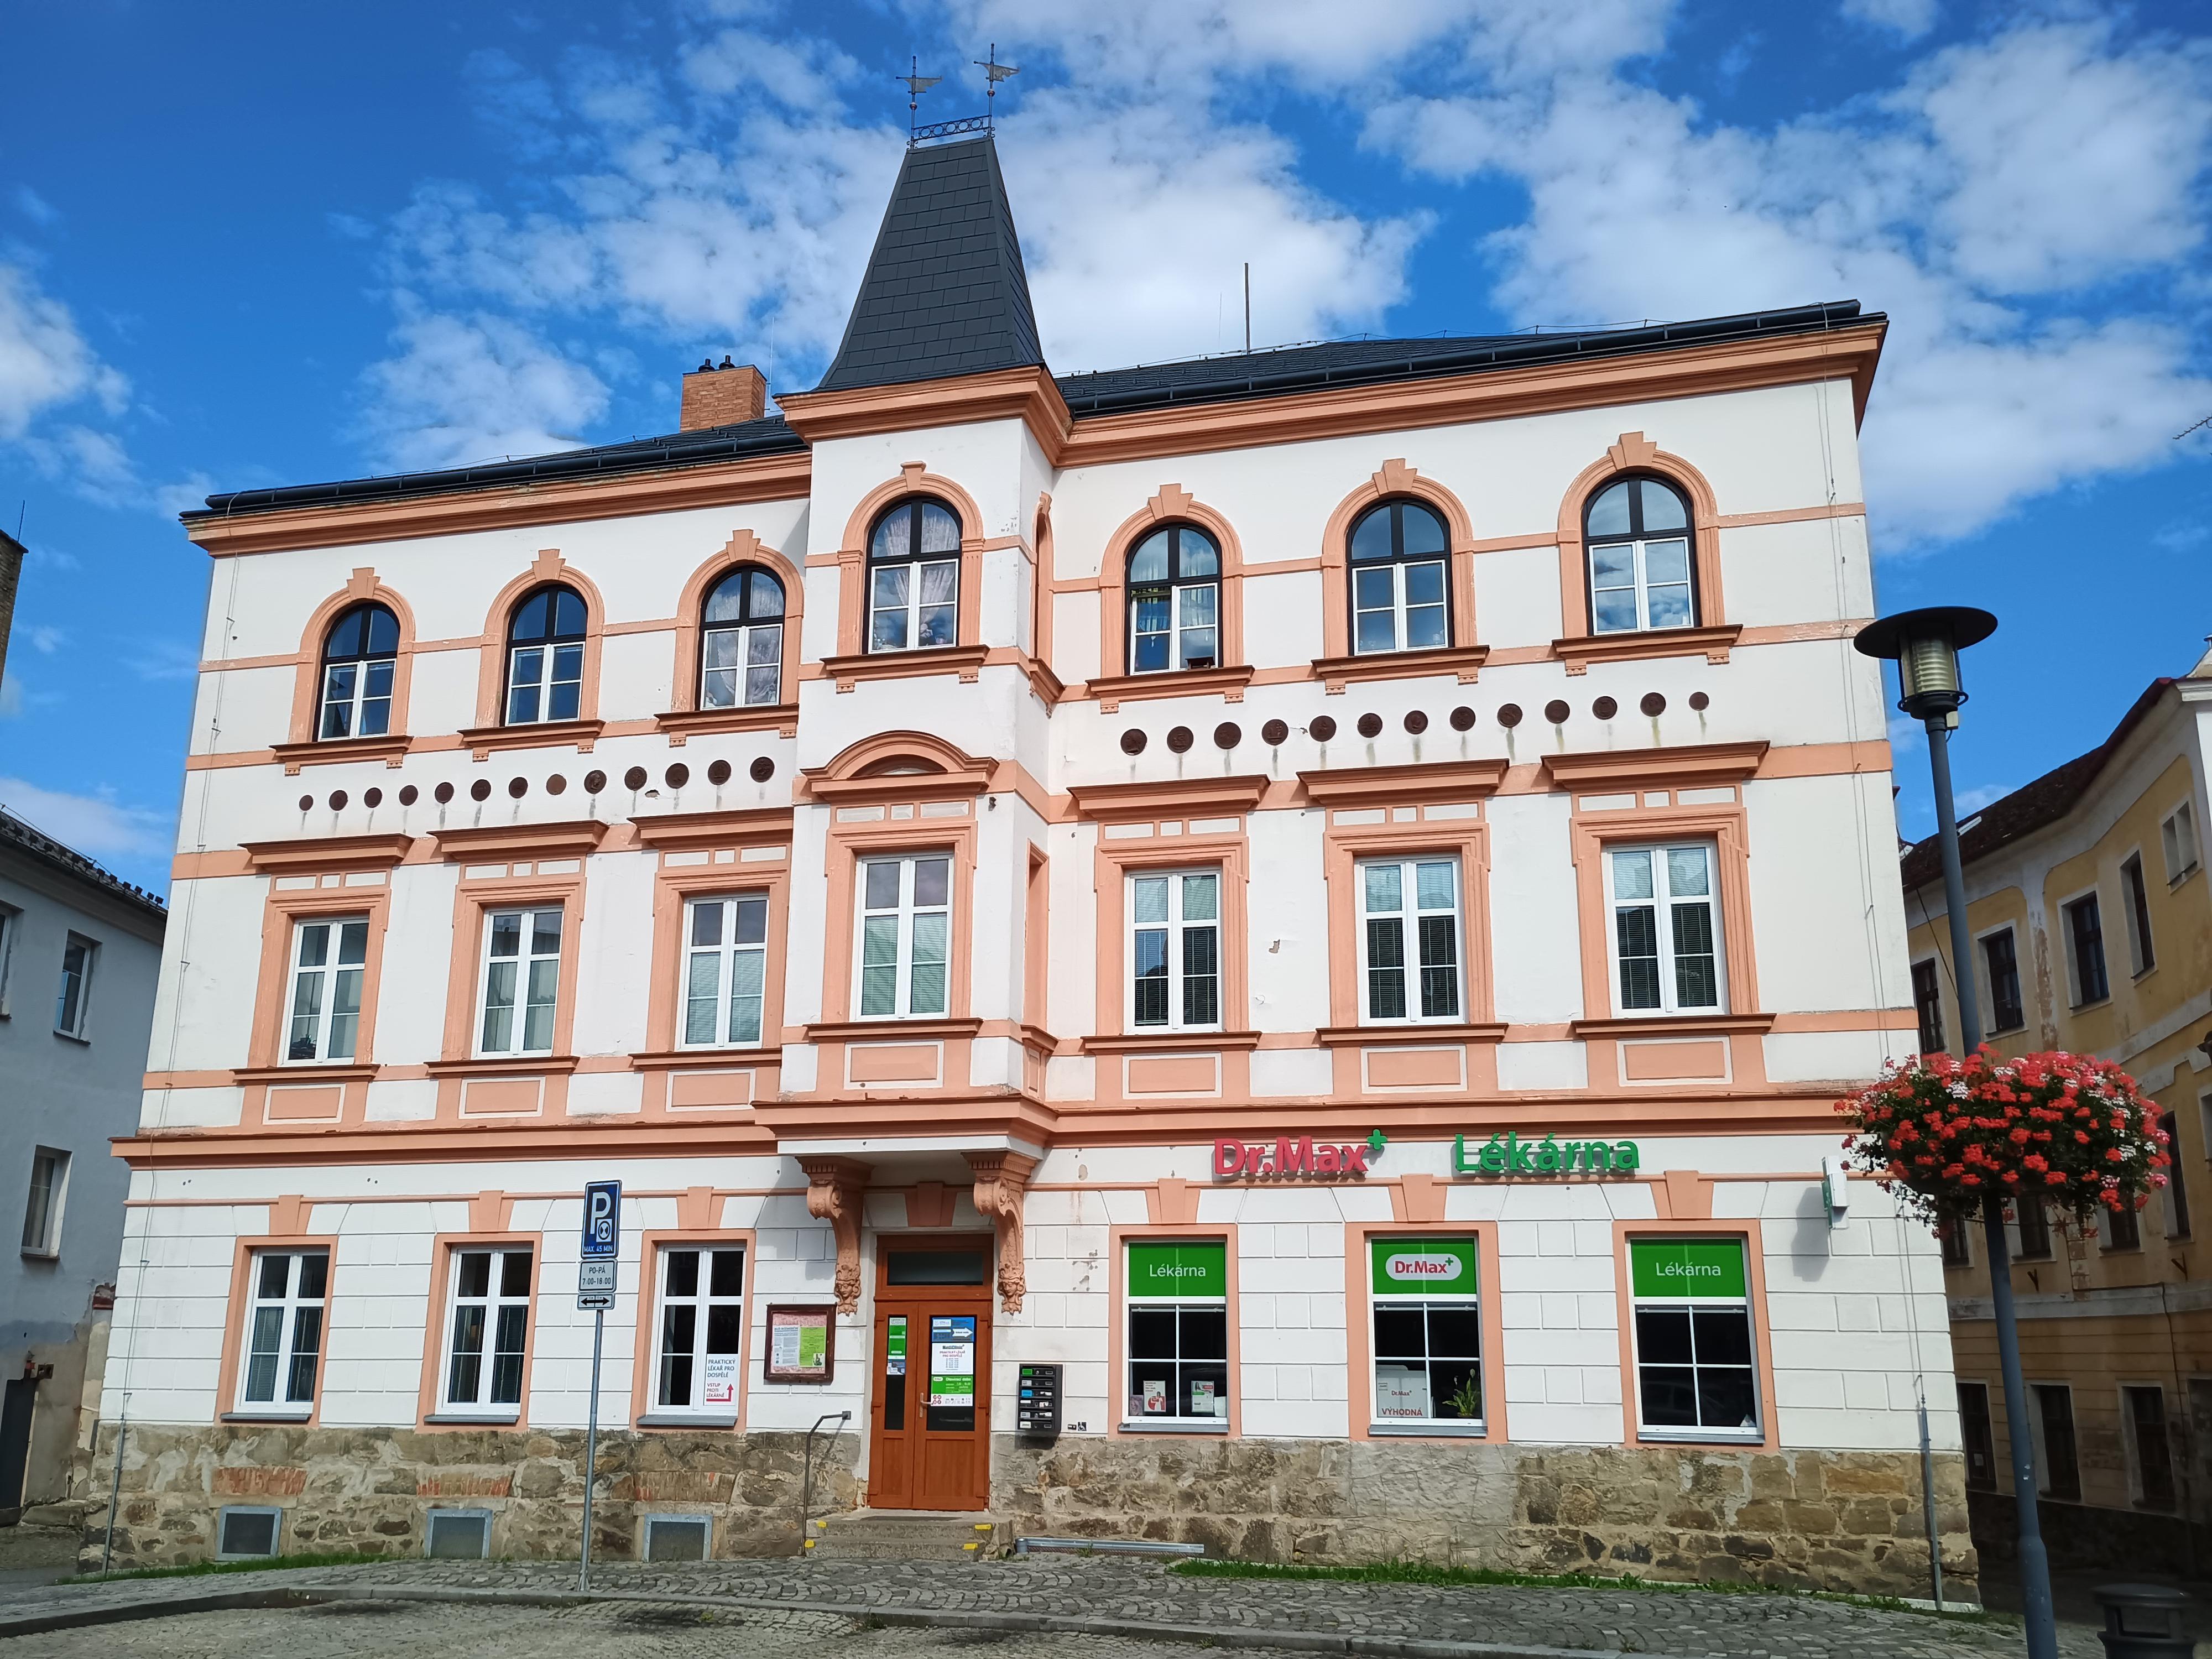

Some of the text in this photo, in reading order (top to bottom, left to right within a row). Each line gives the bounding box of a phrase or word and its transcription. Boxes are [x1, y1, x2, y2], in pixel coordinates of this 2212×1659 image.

[1455, 1131, 1640, 1171] Lékárna
[590, 1192, 611, 1234] P
[589, 1265, 606, 1274] PO-PÁ
[1150, 1263, 1206, 1277] Lékárna
[1656, 1261, 1721, 1276] Lékárna
[1381, 1407, 1423, 1416] VÝHODNÁ
